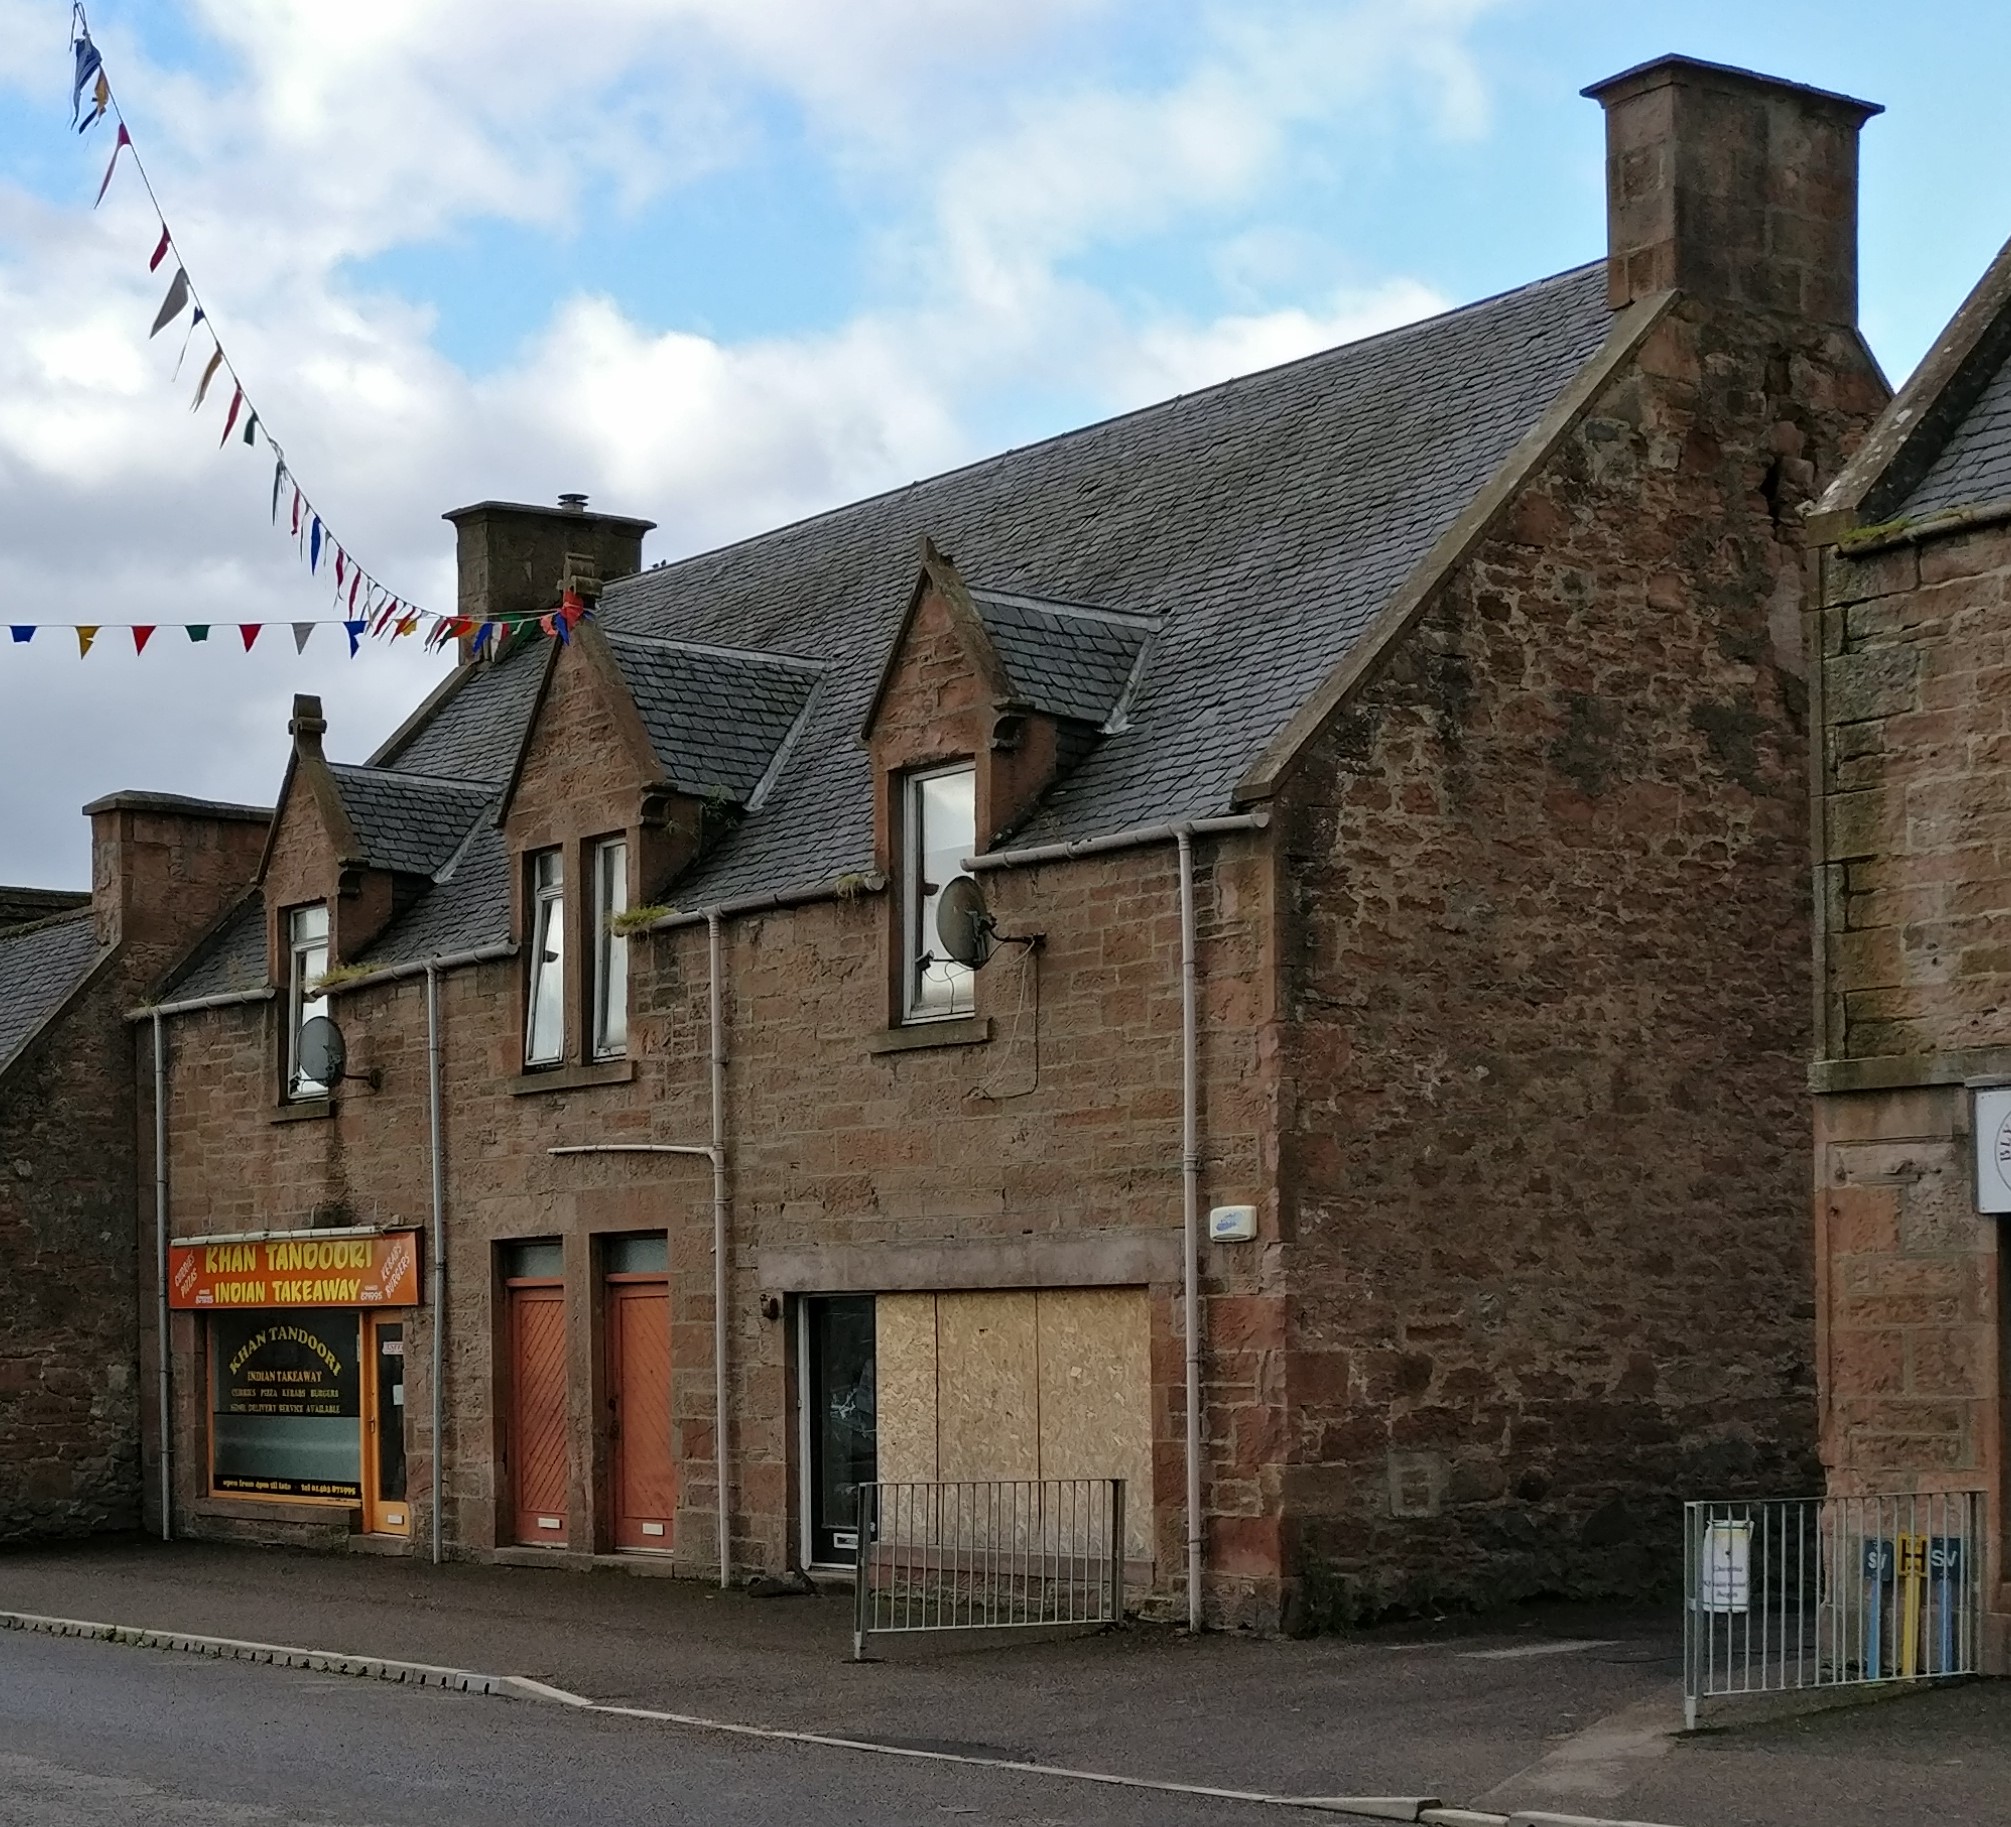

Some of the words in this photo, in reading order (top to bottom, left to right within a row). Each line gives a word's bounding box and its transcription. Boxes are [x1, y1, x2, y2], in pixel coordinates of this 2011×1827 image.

[205, 1244, 257, 1273] KHAN
[265, 1240, 372, 1271] TANDOORI
[385, 1250, 410, 1299] BURGERS
[215, 1281, 266, 1303] INDIAN
[272, 1278, 361, 1302] TAKEAWAY
[229, 1330, 267, 1375] KHAN
[268, 1326, 342, 1377] TANDOORI
[247, 1370, 276, 1383] INDIAN
[277, 1370, 322, 1383] TAKEAWAY
[281, 1388, 307, 1398] KEBABS
[310, 1389, 339, 1398] BURGERS
[248, 1403, 277, 1413] DELIVERY
[278, 1404, 304, 1413] SERVICE
[305, 1404, 341, 1414] AVAILABLE
[1901, 1538, 1927, 1573] H
[1930, 1549, 1958, 1568] SV
